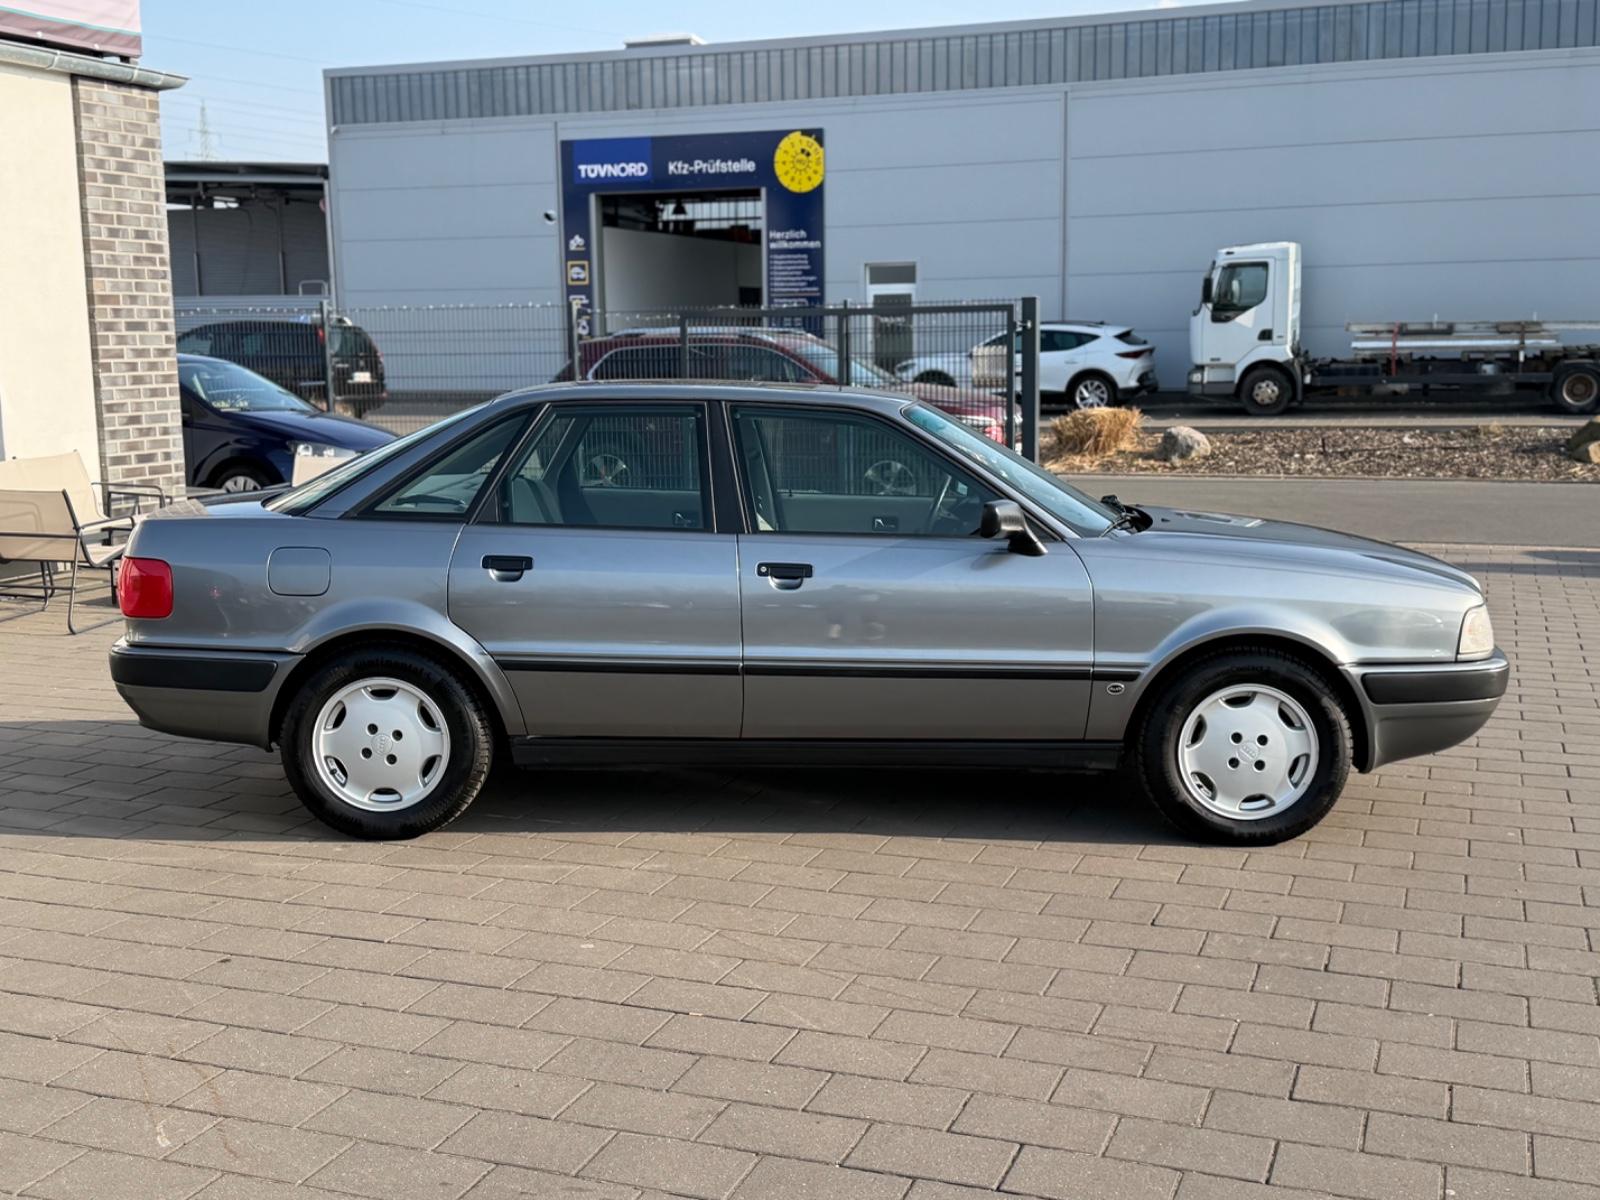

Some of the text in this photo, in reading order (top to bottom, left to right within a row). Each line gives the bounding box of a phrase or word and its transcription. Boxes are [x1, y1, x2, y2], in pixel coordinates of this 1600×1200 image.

[668, 158, 756, 175] Kfz-Prüfstelle
[769, 230, 807, 239] Herzlich
[769, 240, 821, 249] willkommen
